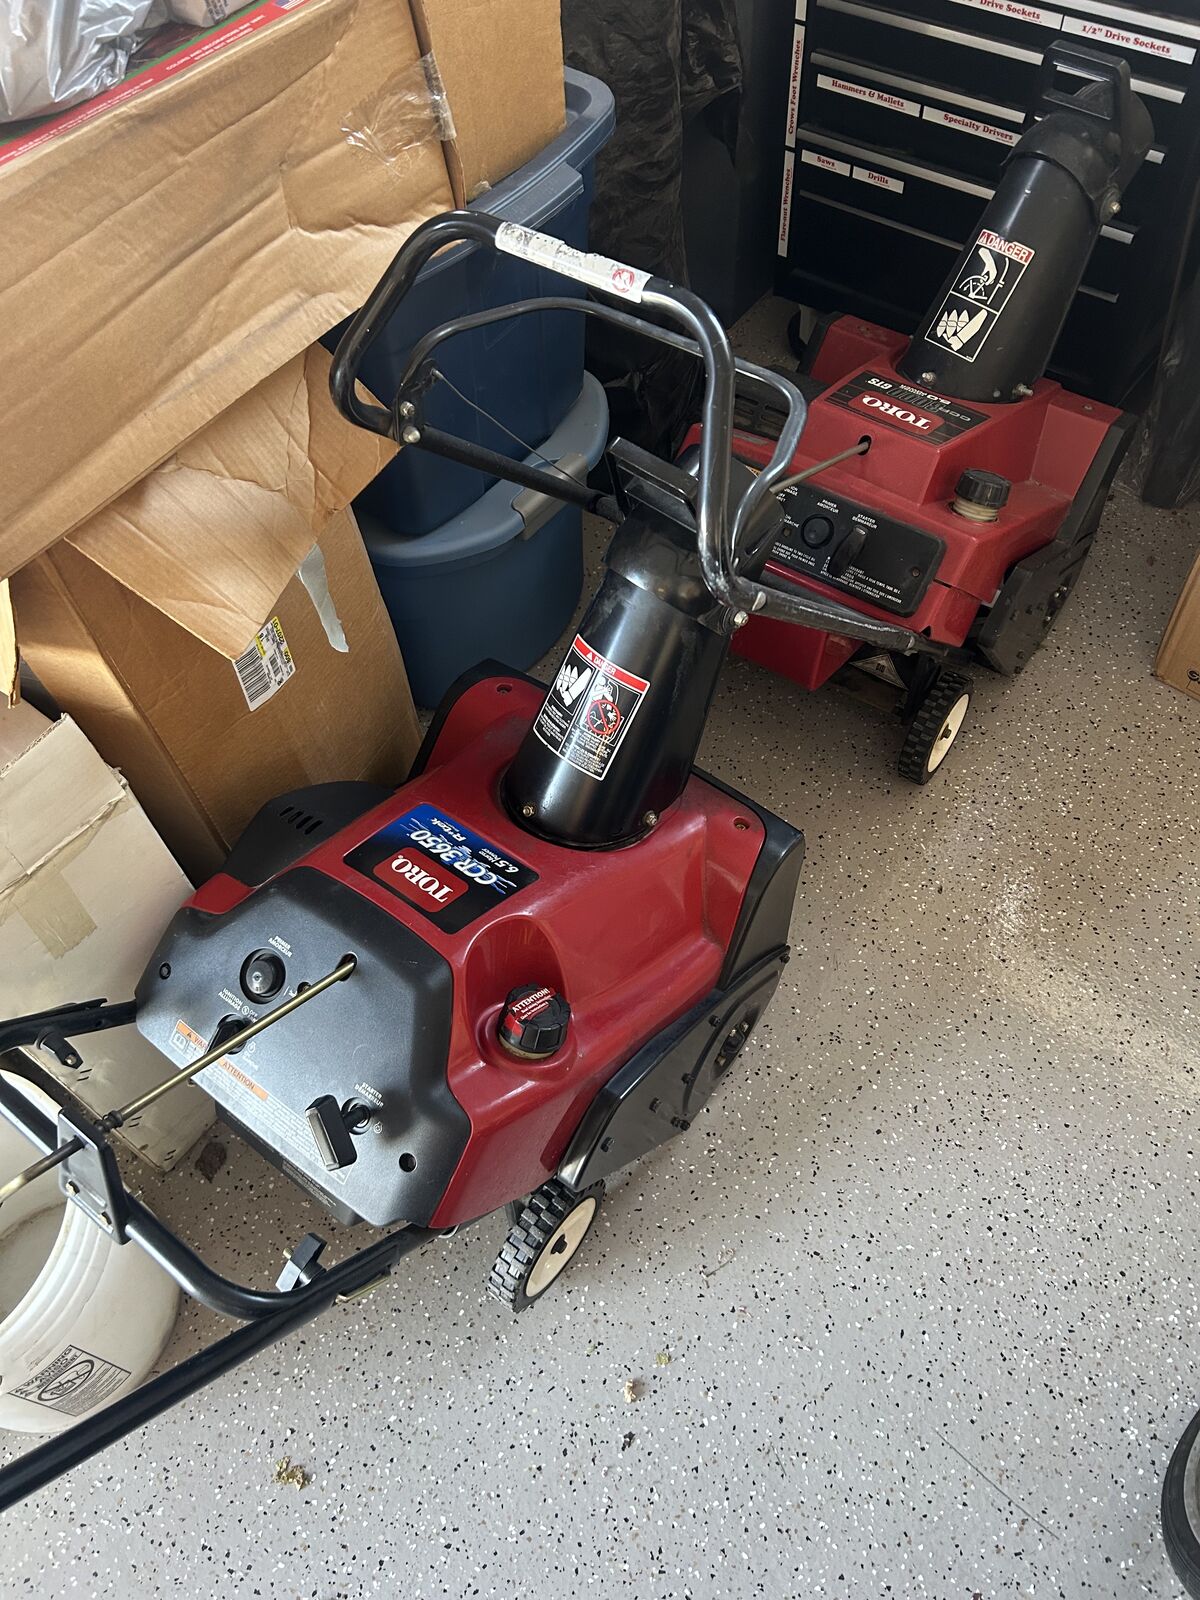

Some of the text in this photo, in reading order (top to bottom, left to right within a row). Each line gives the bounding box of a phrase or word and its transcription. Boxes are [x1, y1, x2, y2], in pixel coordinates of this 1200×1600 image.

[1006, 4, 1041, 20] Sockets
[1105, 29, 1131, 44] Drive
[1132, 37, 1171, 54] Sockets
[787, 39, 801, 135] Crows Foot Wrenches
[831, 79, 867, 97] Hammers
[868, 90, 875, 98] &
[877, 93, 905, 108] Mallets
[943, 113, 981, 132] Specialty
[982, 125, 1014, 141] Drivers
[816, 155, 836, 168] Saws
[782, 168, 791, 206] Wrenches
[867, 171, 889, 185] Drills
[987, 234, 1029, 262] DANGER
[867, 377, 893, 390] GTS
[862, 394, 932, 430] TORO
[409, 829, 498, 885] CCR 3650
[495, 860, 519, 874] 6.5
[391, 854, 454, 903] TORO
[222, 988, 243, 1006] IGNITION
[222, 1059, 256, 1091] ATTENTION
[361, 1082, 383, 1098] STARTER
[23, 1347, 73, 1387] WARNING
[38, 1357, 69, 1383] AVISO
